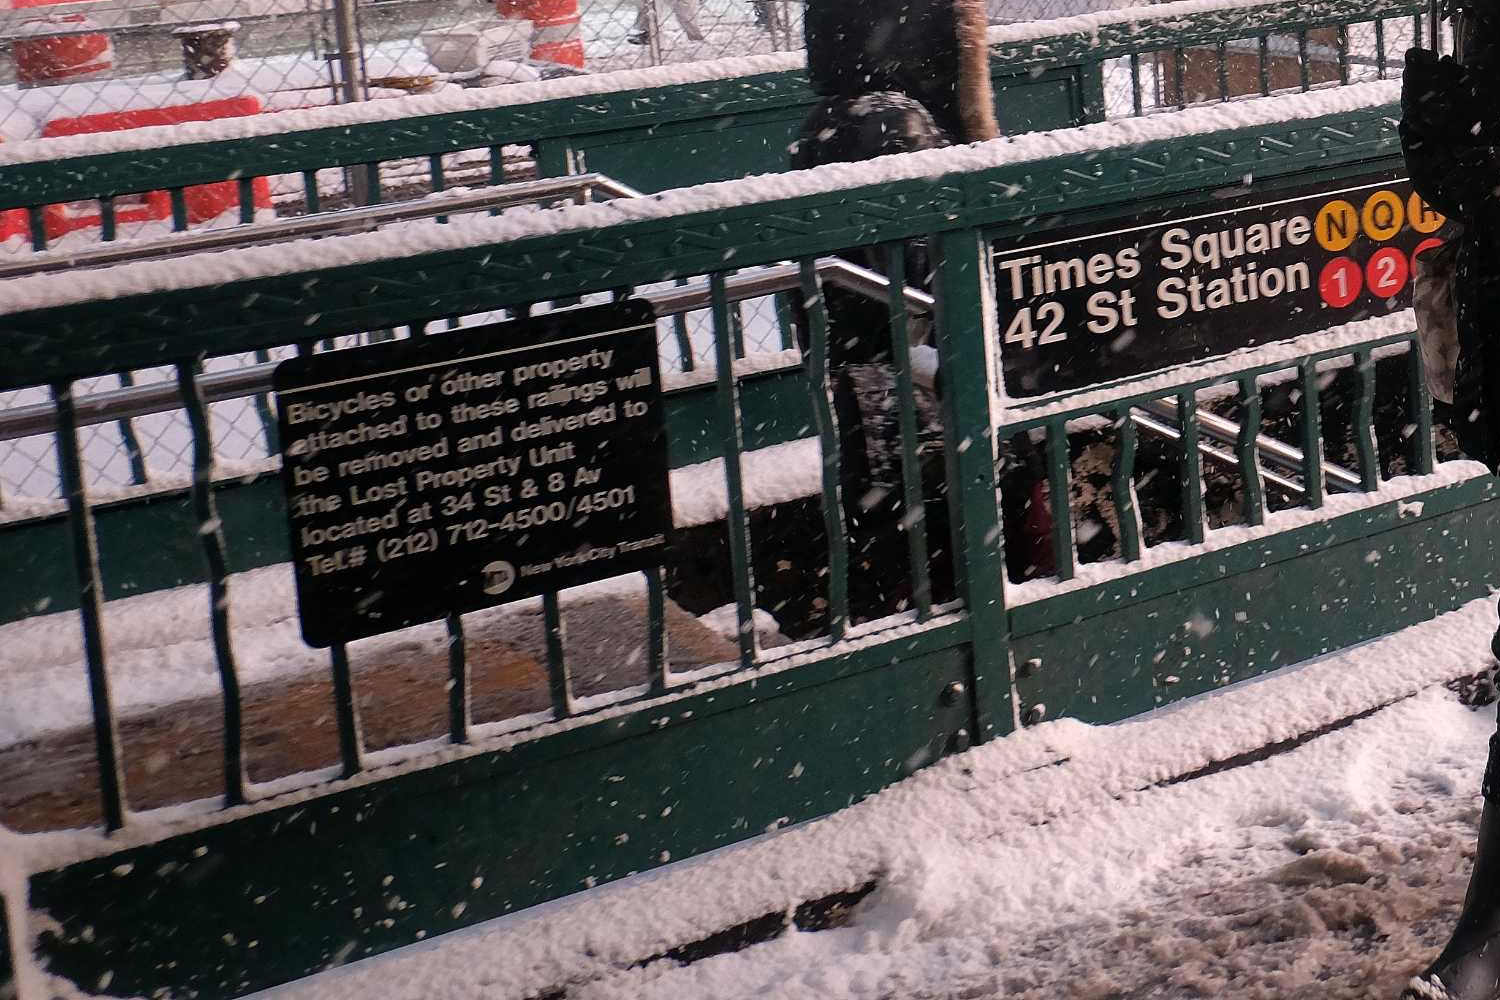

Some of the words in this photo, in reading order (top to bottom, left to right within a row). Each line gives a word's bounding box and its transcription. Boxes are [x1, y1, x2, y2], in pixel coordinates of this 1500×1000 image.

[999, 246, 1141, 300] Times
[1161, 215, 1311, 271] Square
[1003, 301, 1068, 349] 42
[1086, 286, 1139, 336] St
[1156, 257, 1311, 319] Station
[287, 389, 396, 426] Bicycles
[404, 383, 430, 403] or
[440, 369, 505, 395] other
[512, 347, 615, 384] property
[287, 414, 408, 457] attached
[416, 410, 442, 432] to
[450, 397, 520, 424] these
[527, 380, 608, 409] railings
[615, 366, 652, 391] will
[294, 464, 328, 486] be
[338, 437, 450, 478] removed
[457, 428, 502, 454] and
[511, 406, 617, 443] delivered
[623, 398, 649, 420] to
[298, 491, 342, 516] the
[350, 479, 408, 507] Lost
[415, 456, 521, 494] Property
[529, 441, 576, 468] Unit
[302, 514, 399, 548] located
[407, 501, 433, 524] at
[440, 489, 475, 514] 34
[483, 484, 513, 507] St
[520, 478, 540, 500] &
[547, 472, 565, 494] 8
[572, 465, 602, 490] Av
[306, 549, 369, 579] Tel.#
[376, 533, 440, 563] (212)
[447, 484, 637, 545] 712-4500/4501
